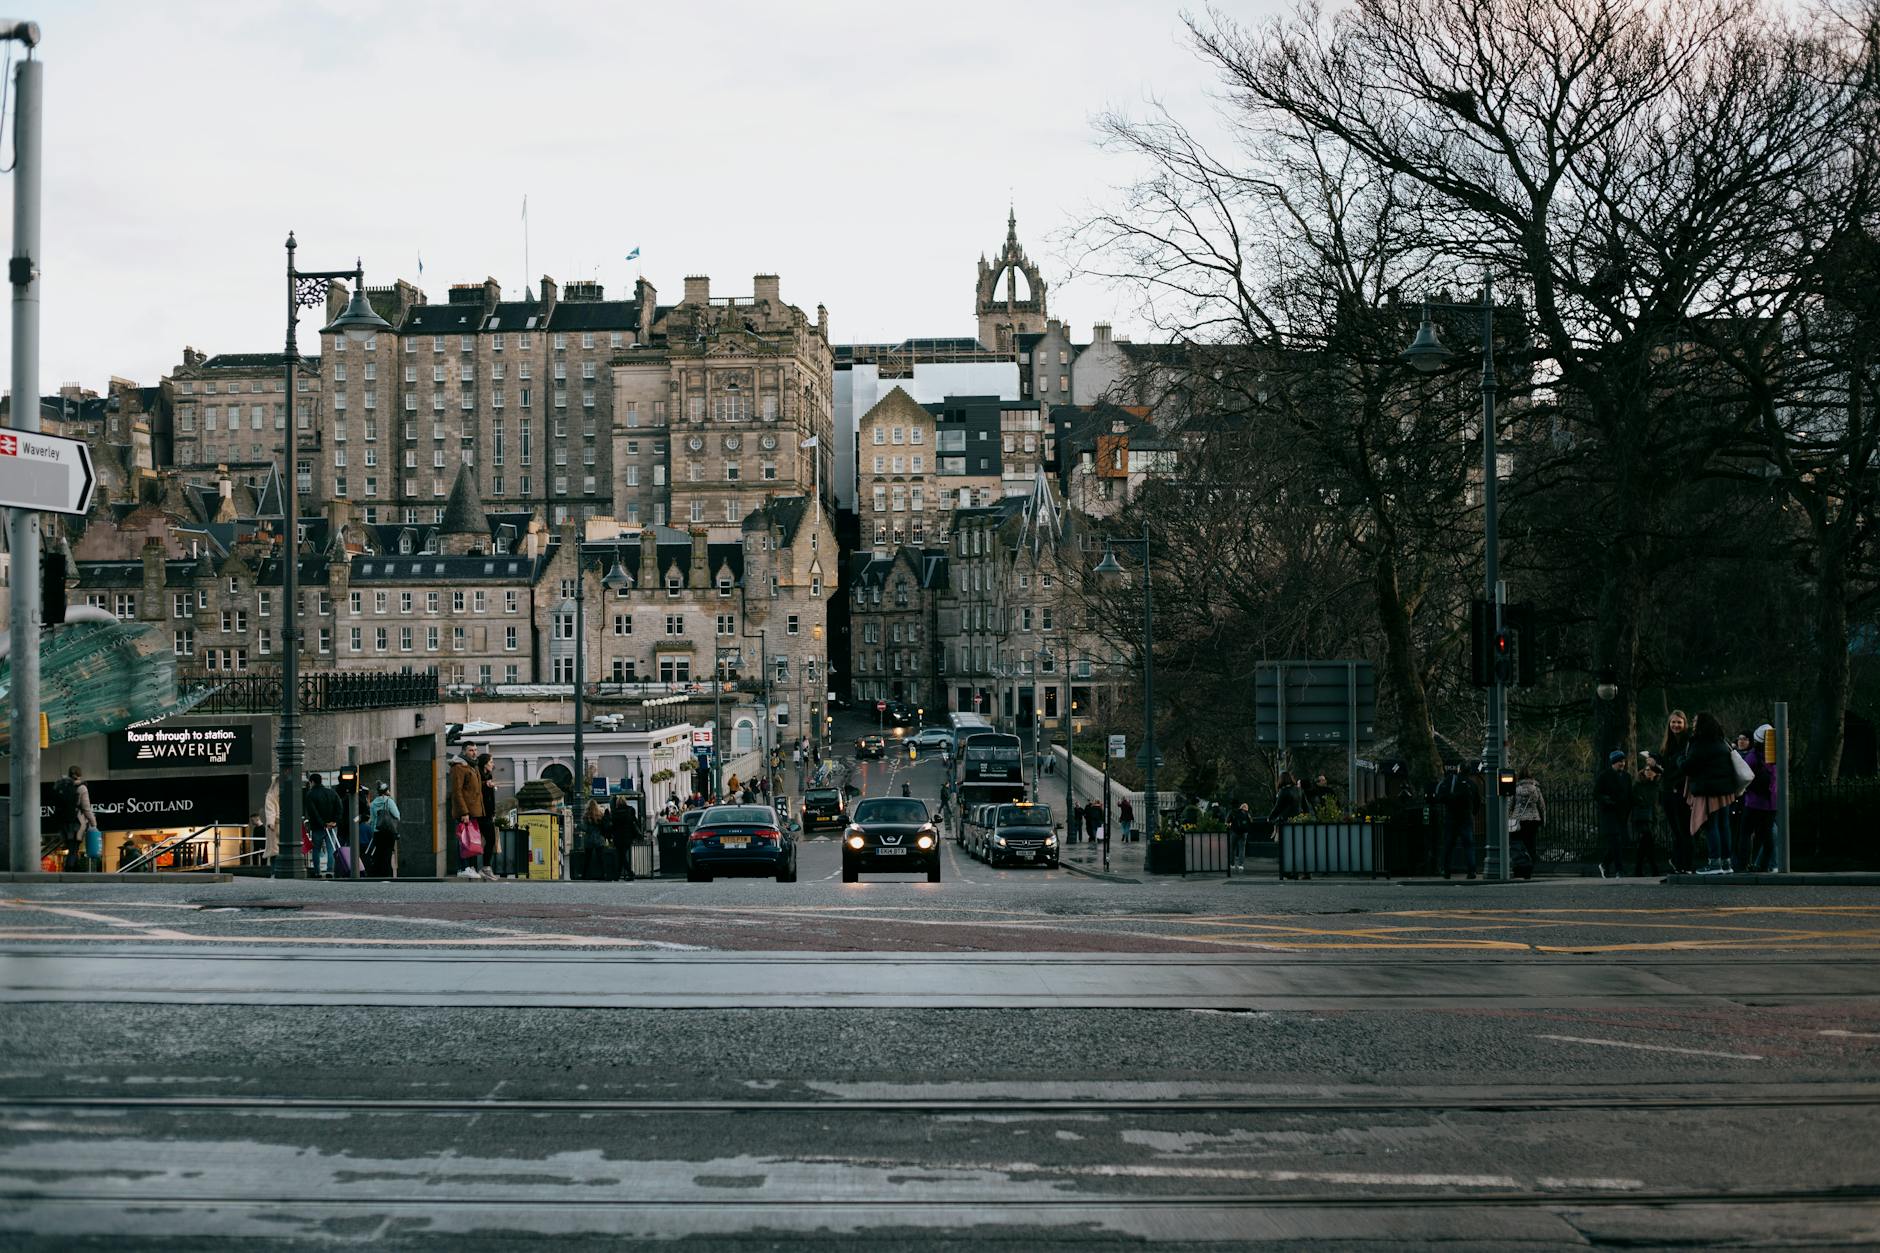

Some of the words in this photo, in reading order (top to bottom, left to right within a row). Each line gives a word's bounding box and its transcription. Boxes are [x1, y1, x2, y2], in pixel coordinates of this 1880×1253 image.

[23, 441, 60, 460] Waverley
[127, 731, 154, 742] Route
[155, 729, 191, 743] through
[192, 731, 203, 740] to
[204, 729, 237, 740] station.
[152, 742, 232, 757] WAVERLEY
[209, 752, 227, 763] mall
